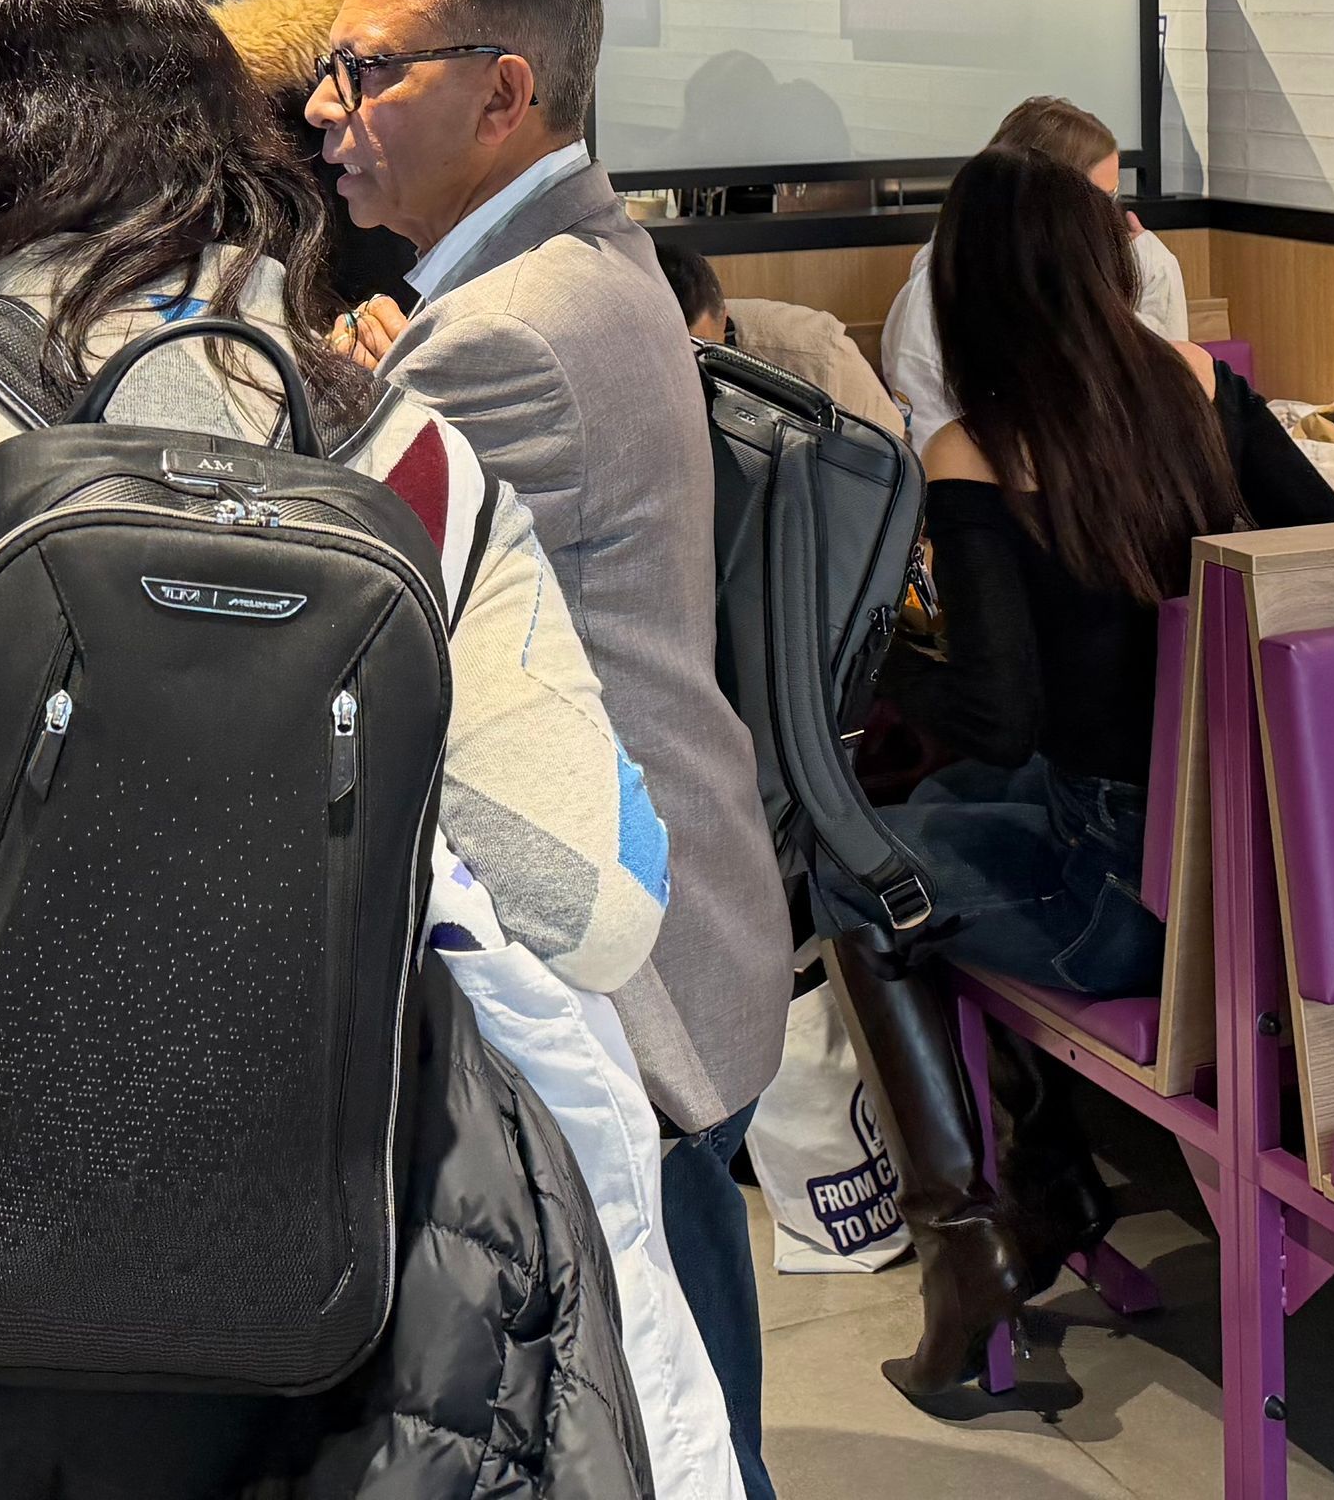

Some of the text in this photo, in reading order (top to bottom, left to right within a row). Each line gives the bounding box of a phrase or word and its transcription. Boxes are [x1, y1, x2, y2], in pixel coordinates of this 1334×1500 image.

[197, 458, 234, 473] AM
[814, 1170, 878, 1214] FROM
[832, 1216, 866, 1248] TO
